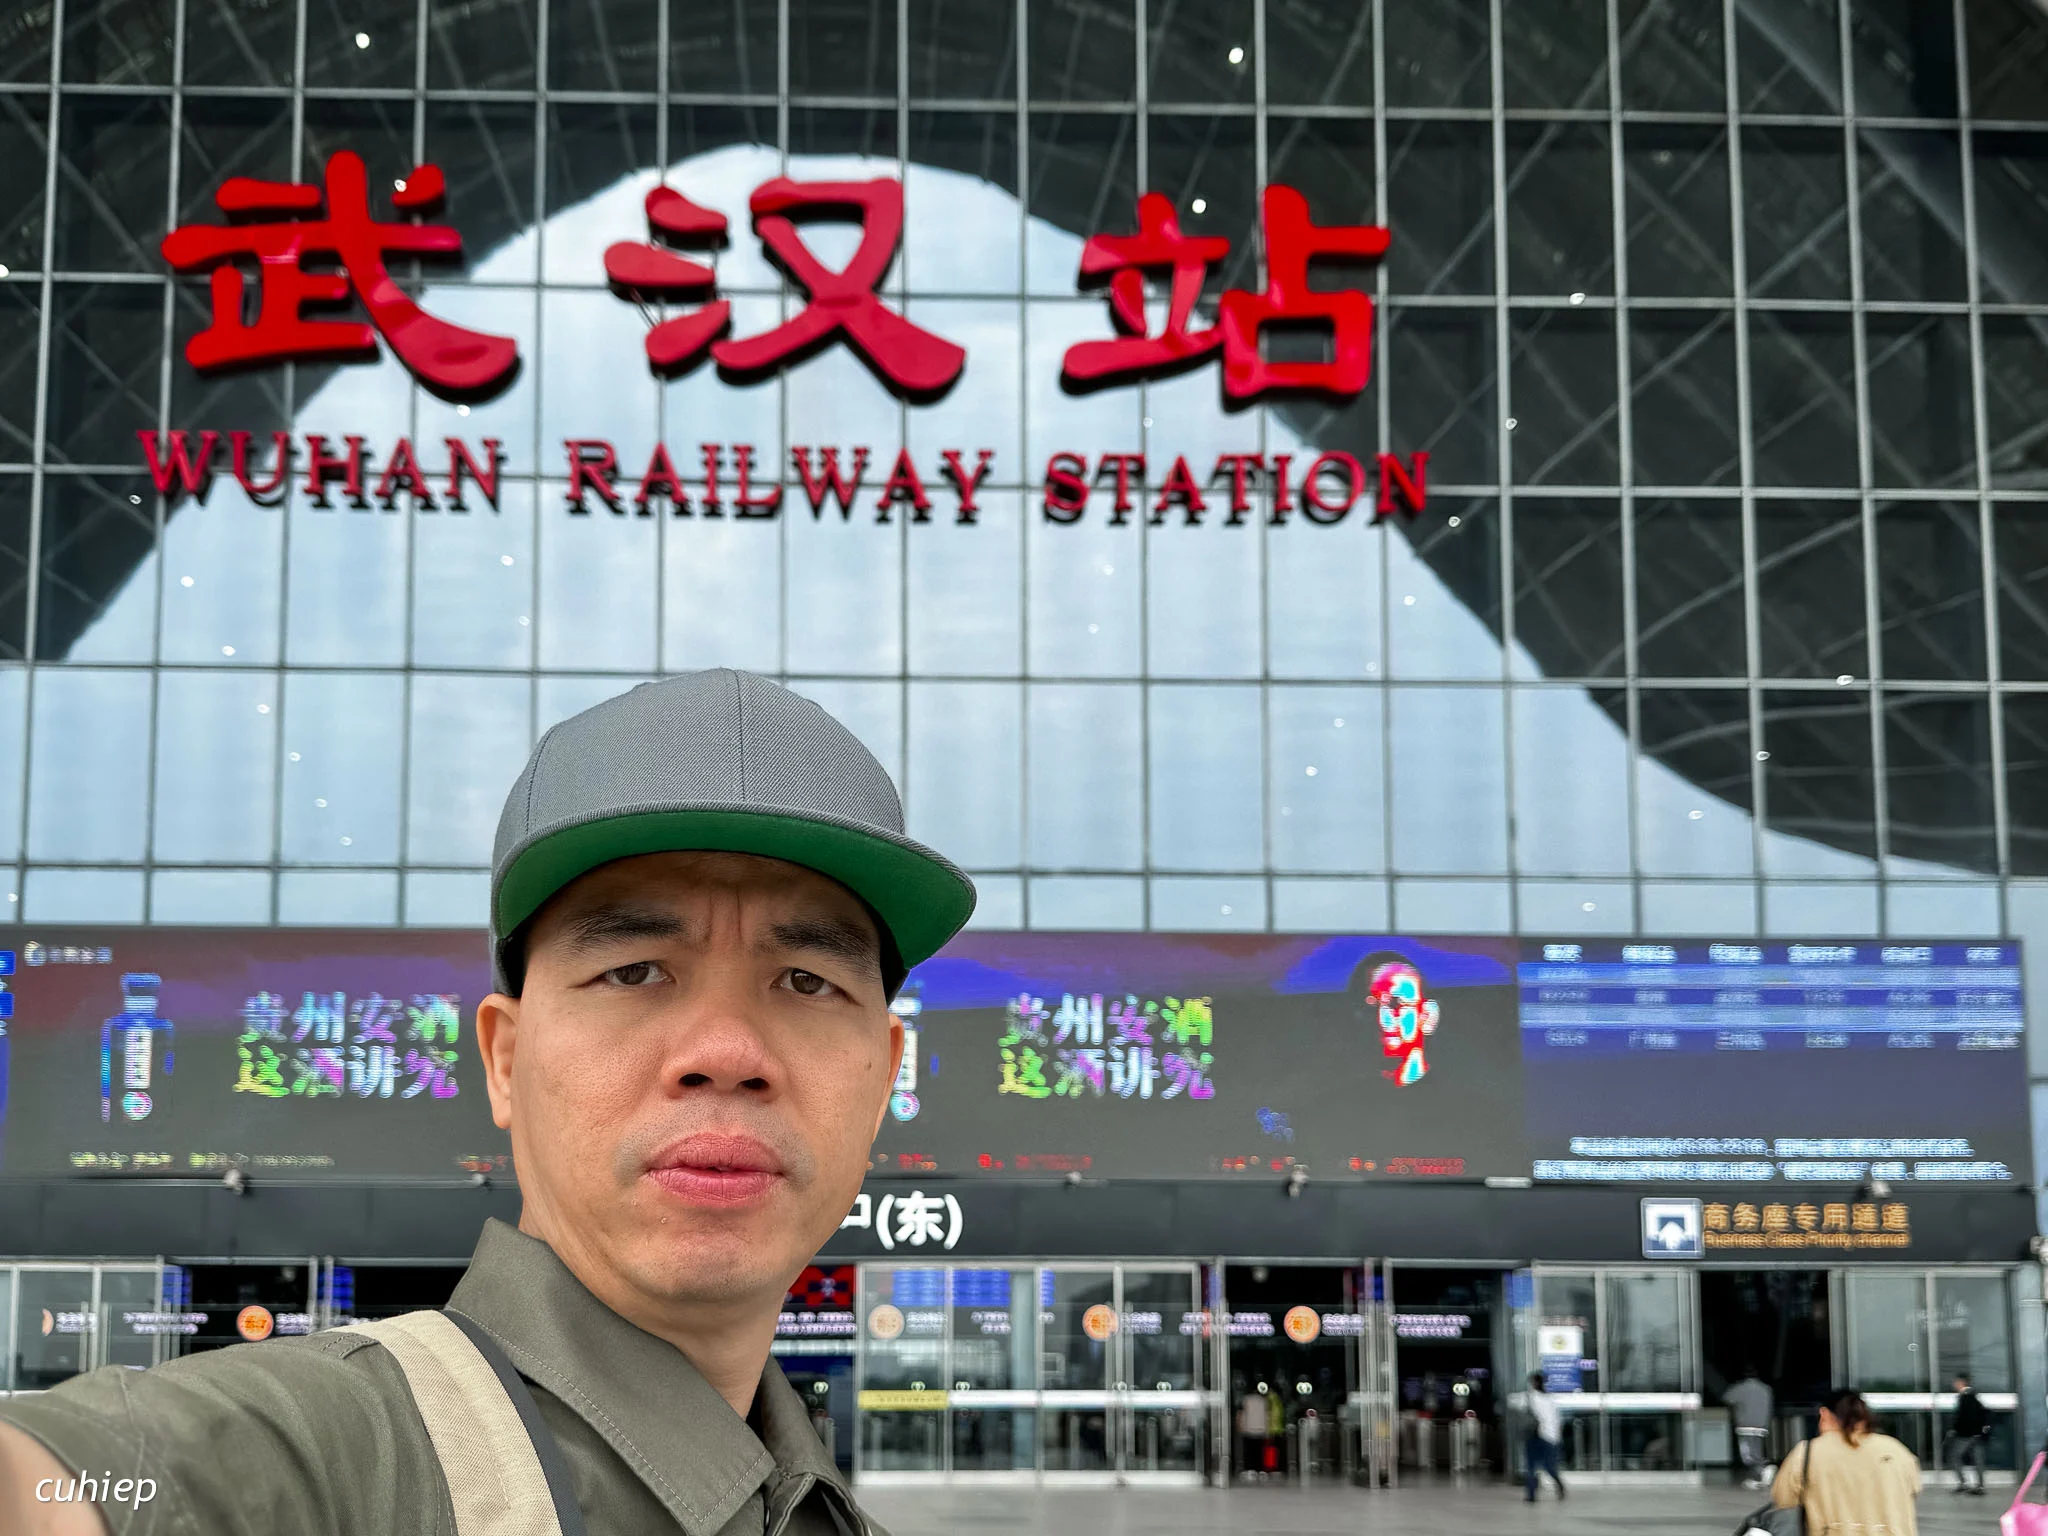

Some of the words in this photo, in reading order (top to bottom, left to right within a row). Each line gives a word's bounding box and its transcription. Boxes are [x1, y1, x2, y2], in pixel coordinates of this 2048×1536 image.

[161, 149, 1393, 406] 武汉站
[137, 430, 505, 512] WUHAN
[564, 439, 996, 524] RAILWAY
[1043, 449, 1432, 526] STATION
